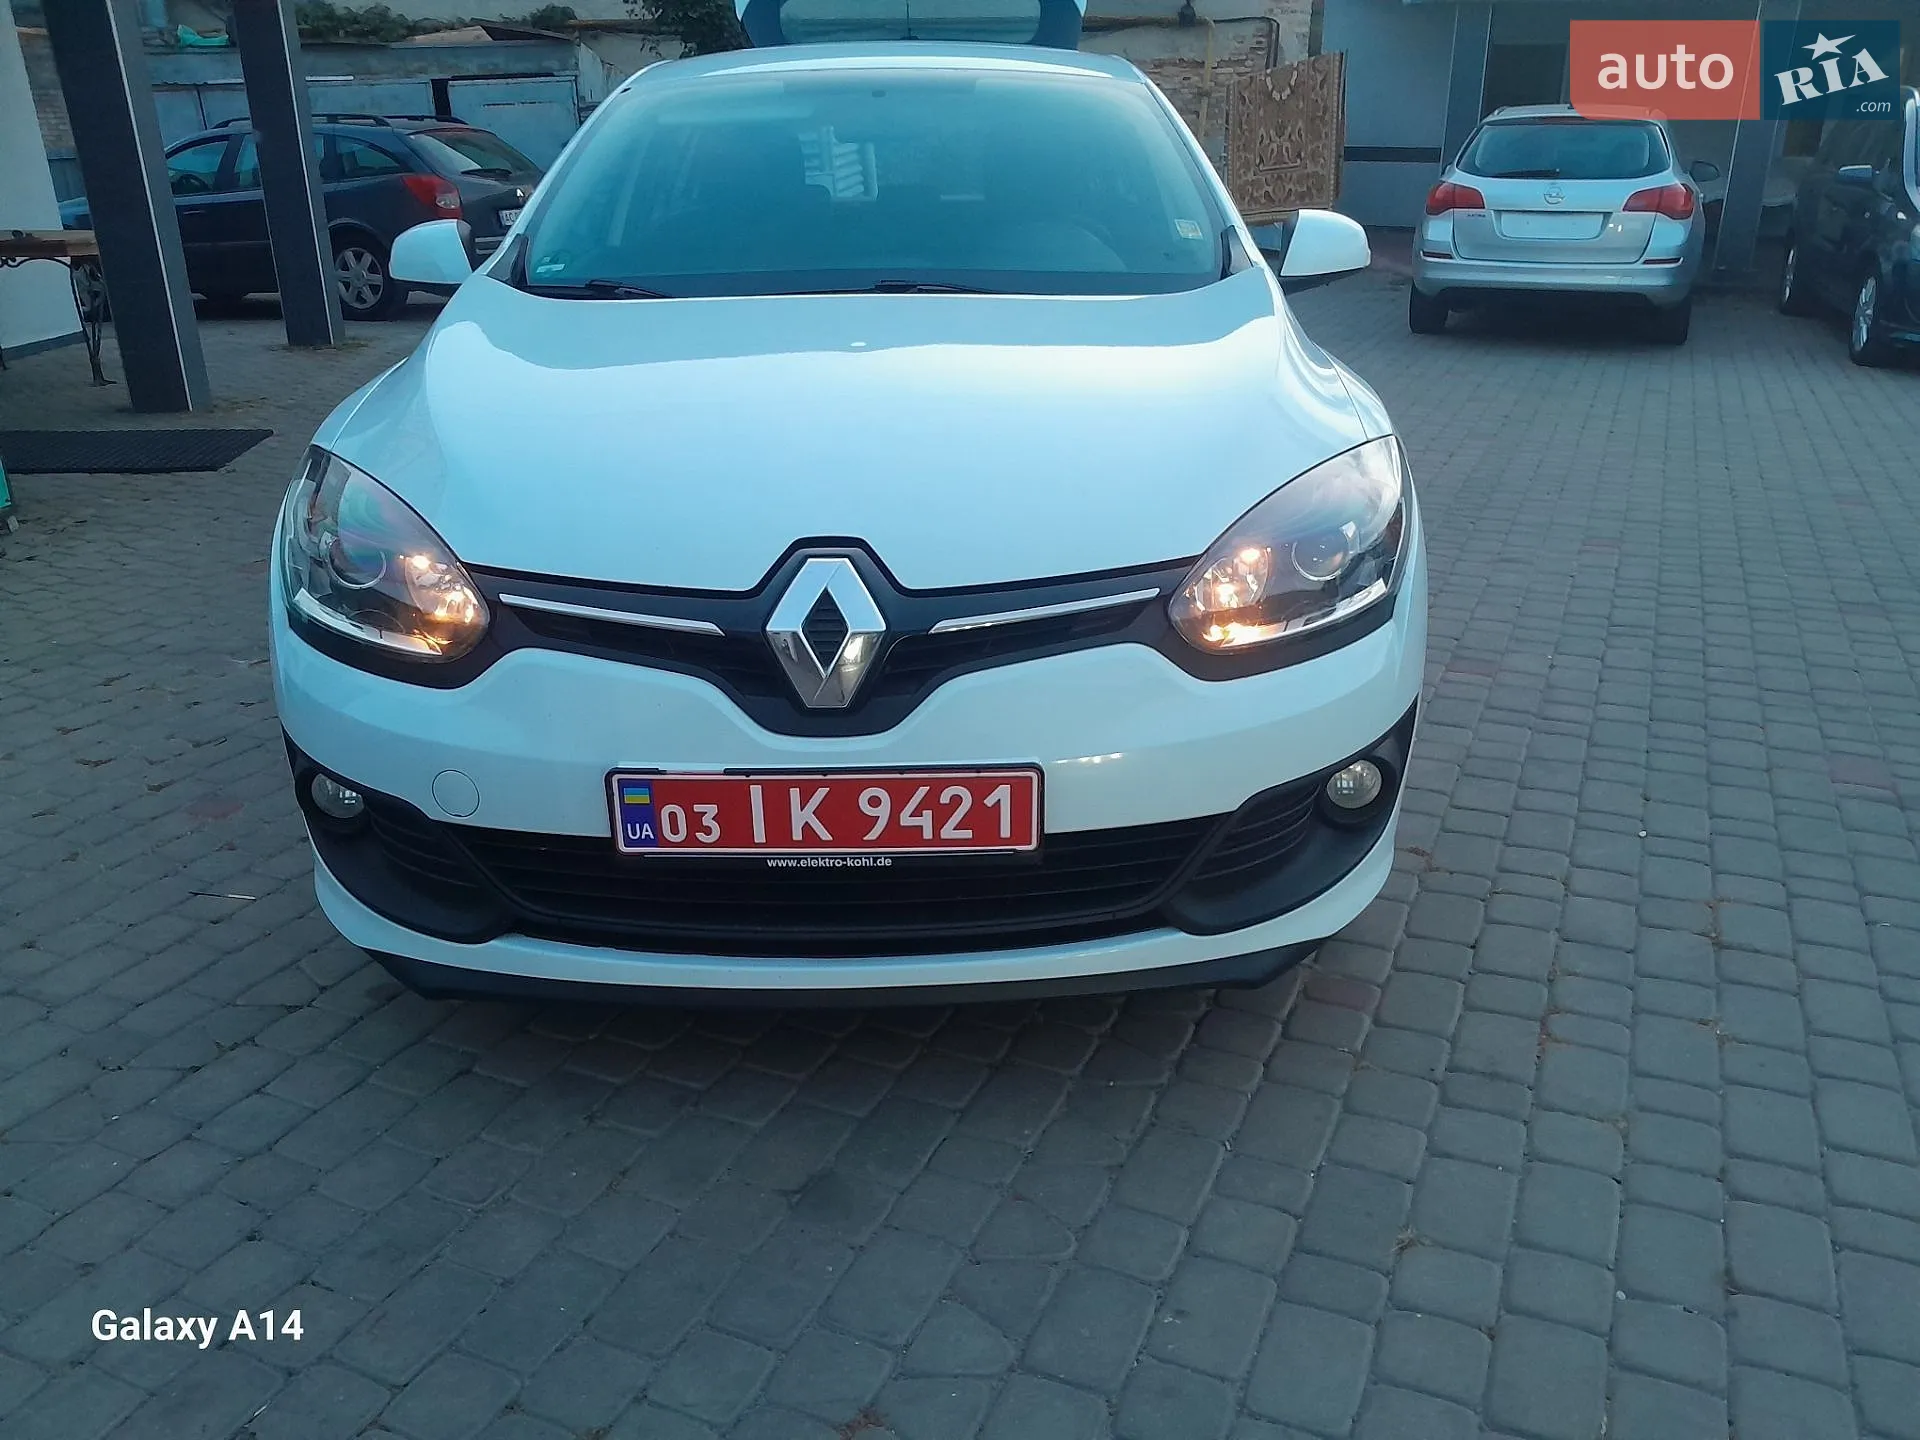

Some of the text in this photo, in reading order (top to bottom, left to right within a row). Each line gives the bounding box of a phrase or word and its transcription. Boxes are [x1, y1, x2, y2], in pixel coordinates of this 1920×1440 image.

[660, 804, 721, 843] 03
[858, 784, 1011, 840] 9421
[627, 823, 654, 839] UA
[766, 857, 892, 868] www.elektro-kohl.de
